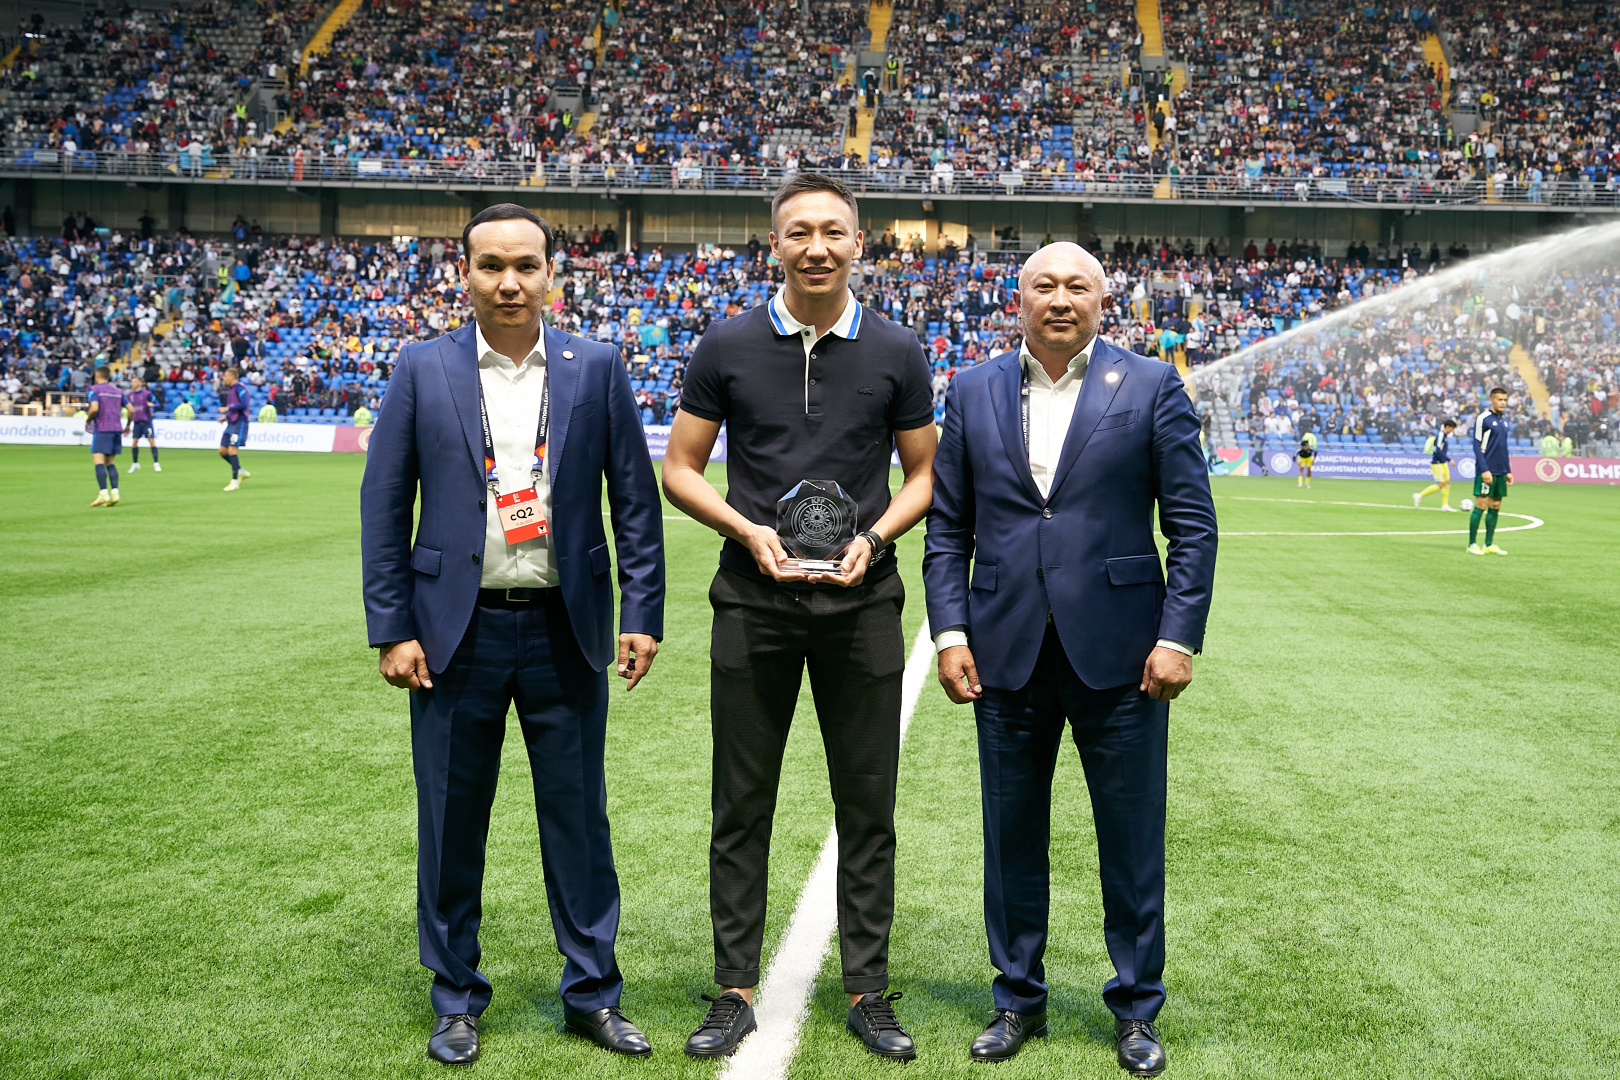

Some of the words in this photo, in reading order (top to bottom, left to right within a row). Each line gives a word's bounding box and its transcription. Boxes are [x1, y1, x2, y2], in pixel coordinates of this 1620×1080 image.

[155, 428, 216, 442] Football
[248, 430, 304, 444] ndation
[1314, 455, 1353, 464] АЗАҚСТАН
[1357, 466, 1394, 475] FOOTBALL
[1394, 467, 1434, 476] FEDERATIO
[510, 506, 535, 521] cQ2
